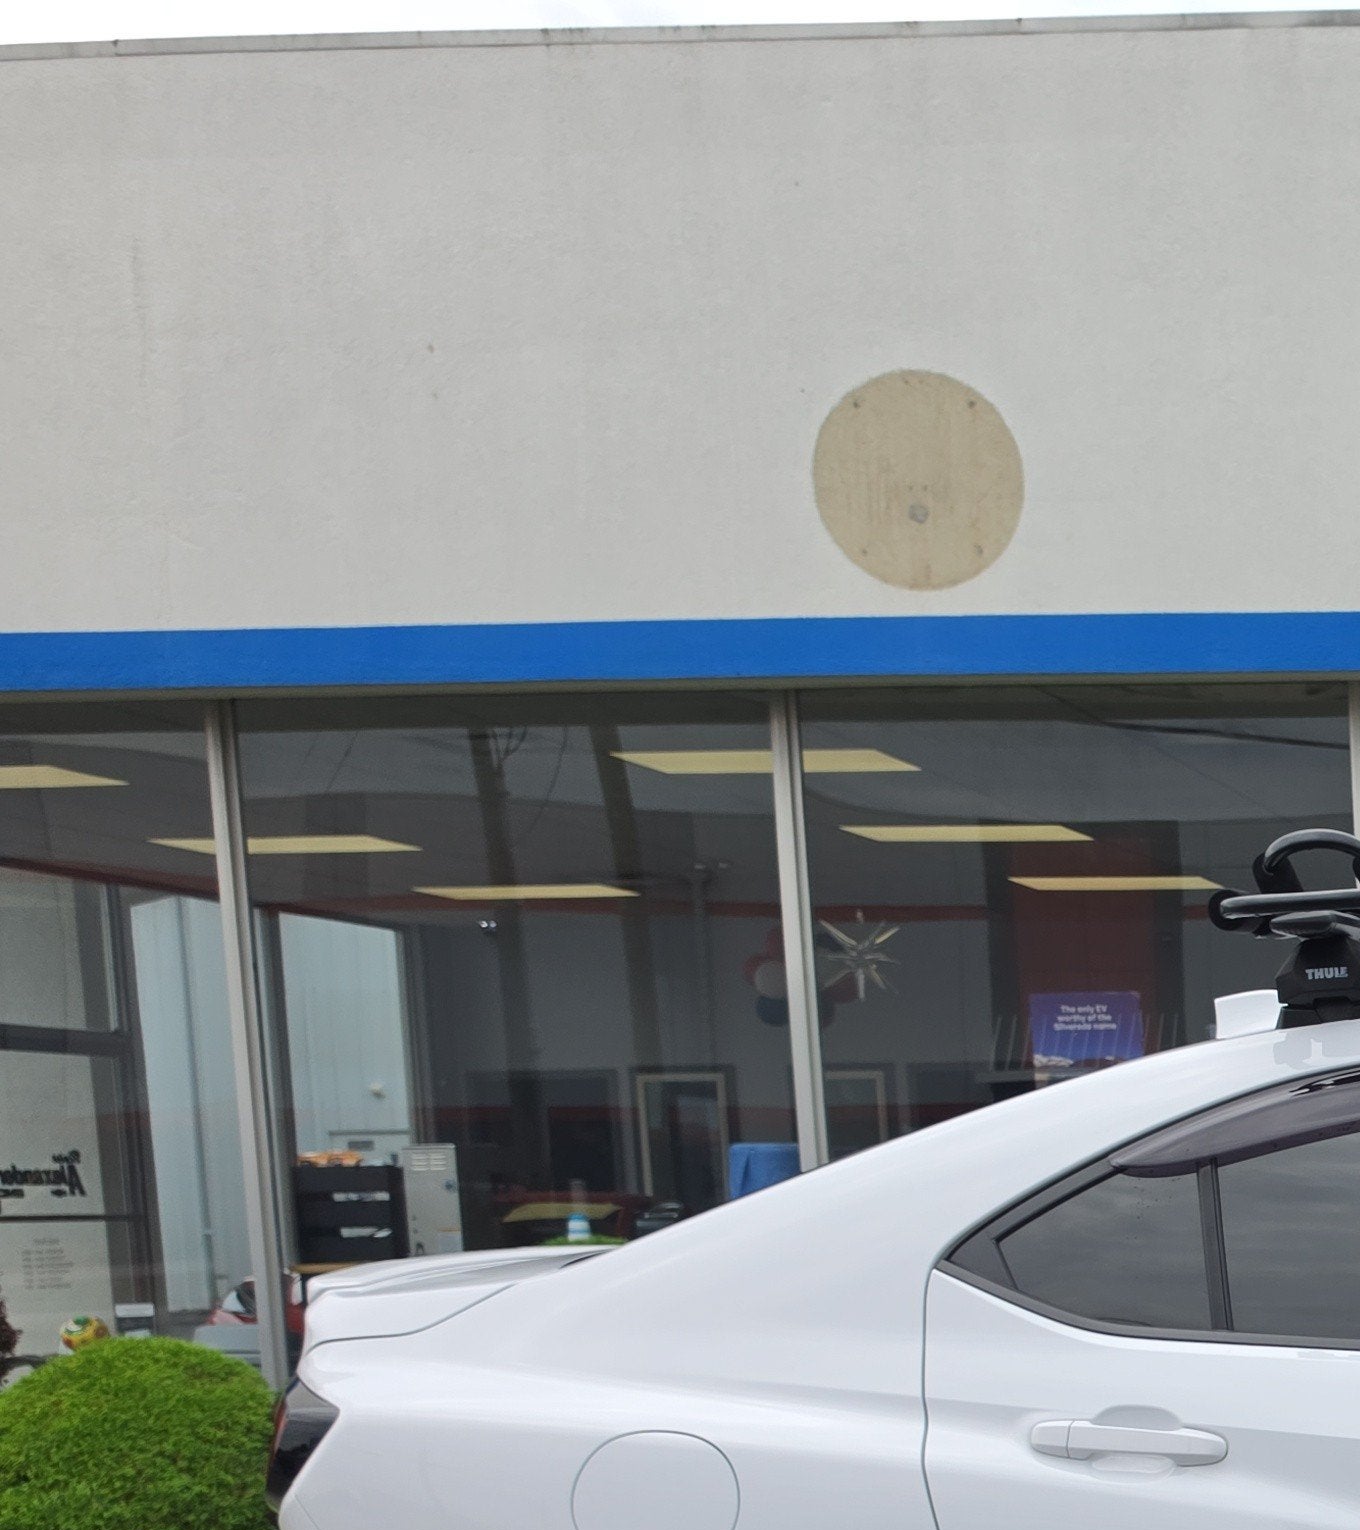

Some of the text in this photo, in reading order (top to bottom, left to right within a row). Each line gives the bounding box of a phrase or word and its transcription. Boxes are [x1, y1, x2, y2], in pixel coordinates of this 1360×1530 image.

[1305, 966, 1349, 980] THULE
[1060, 1004, 1108, 1015] The only EV
